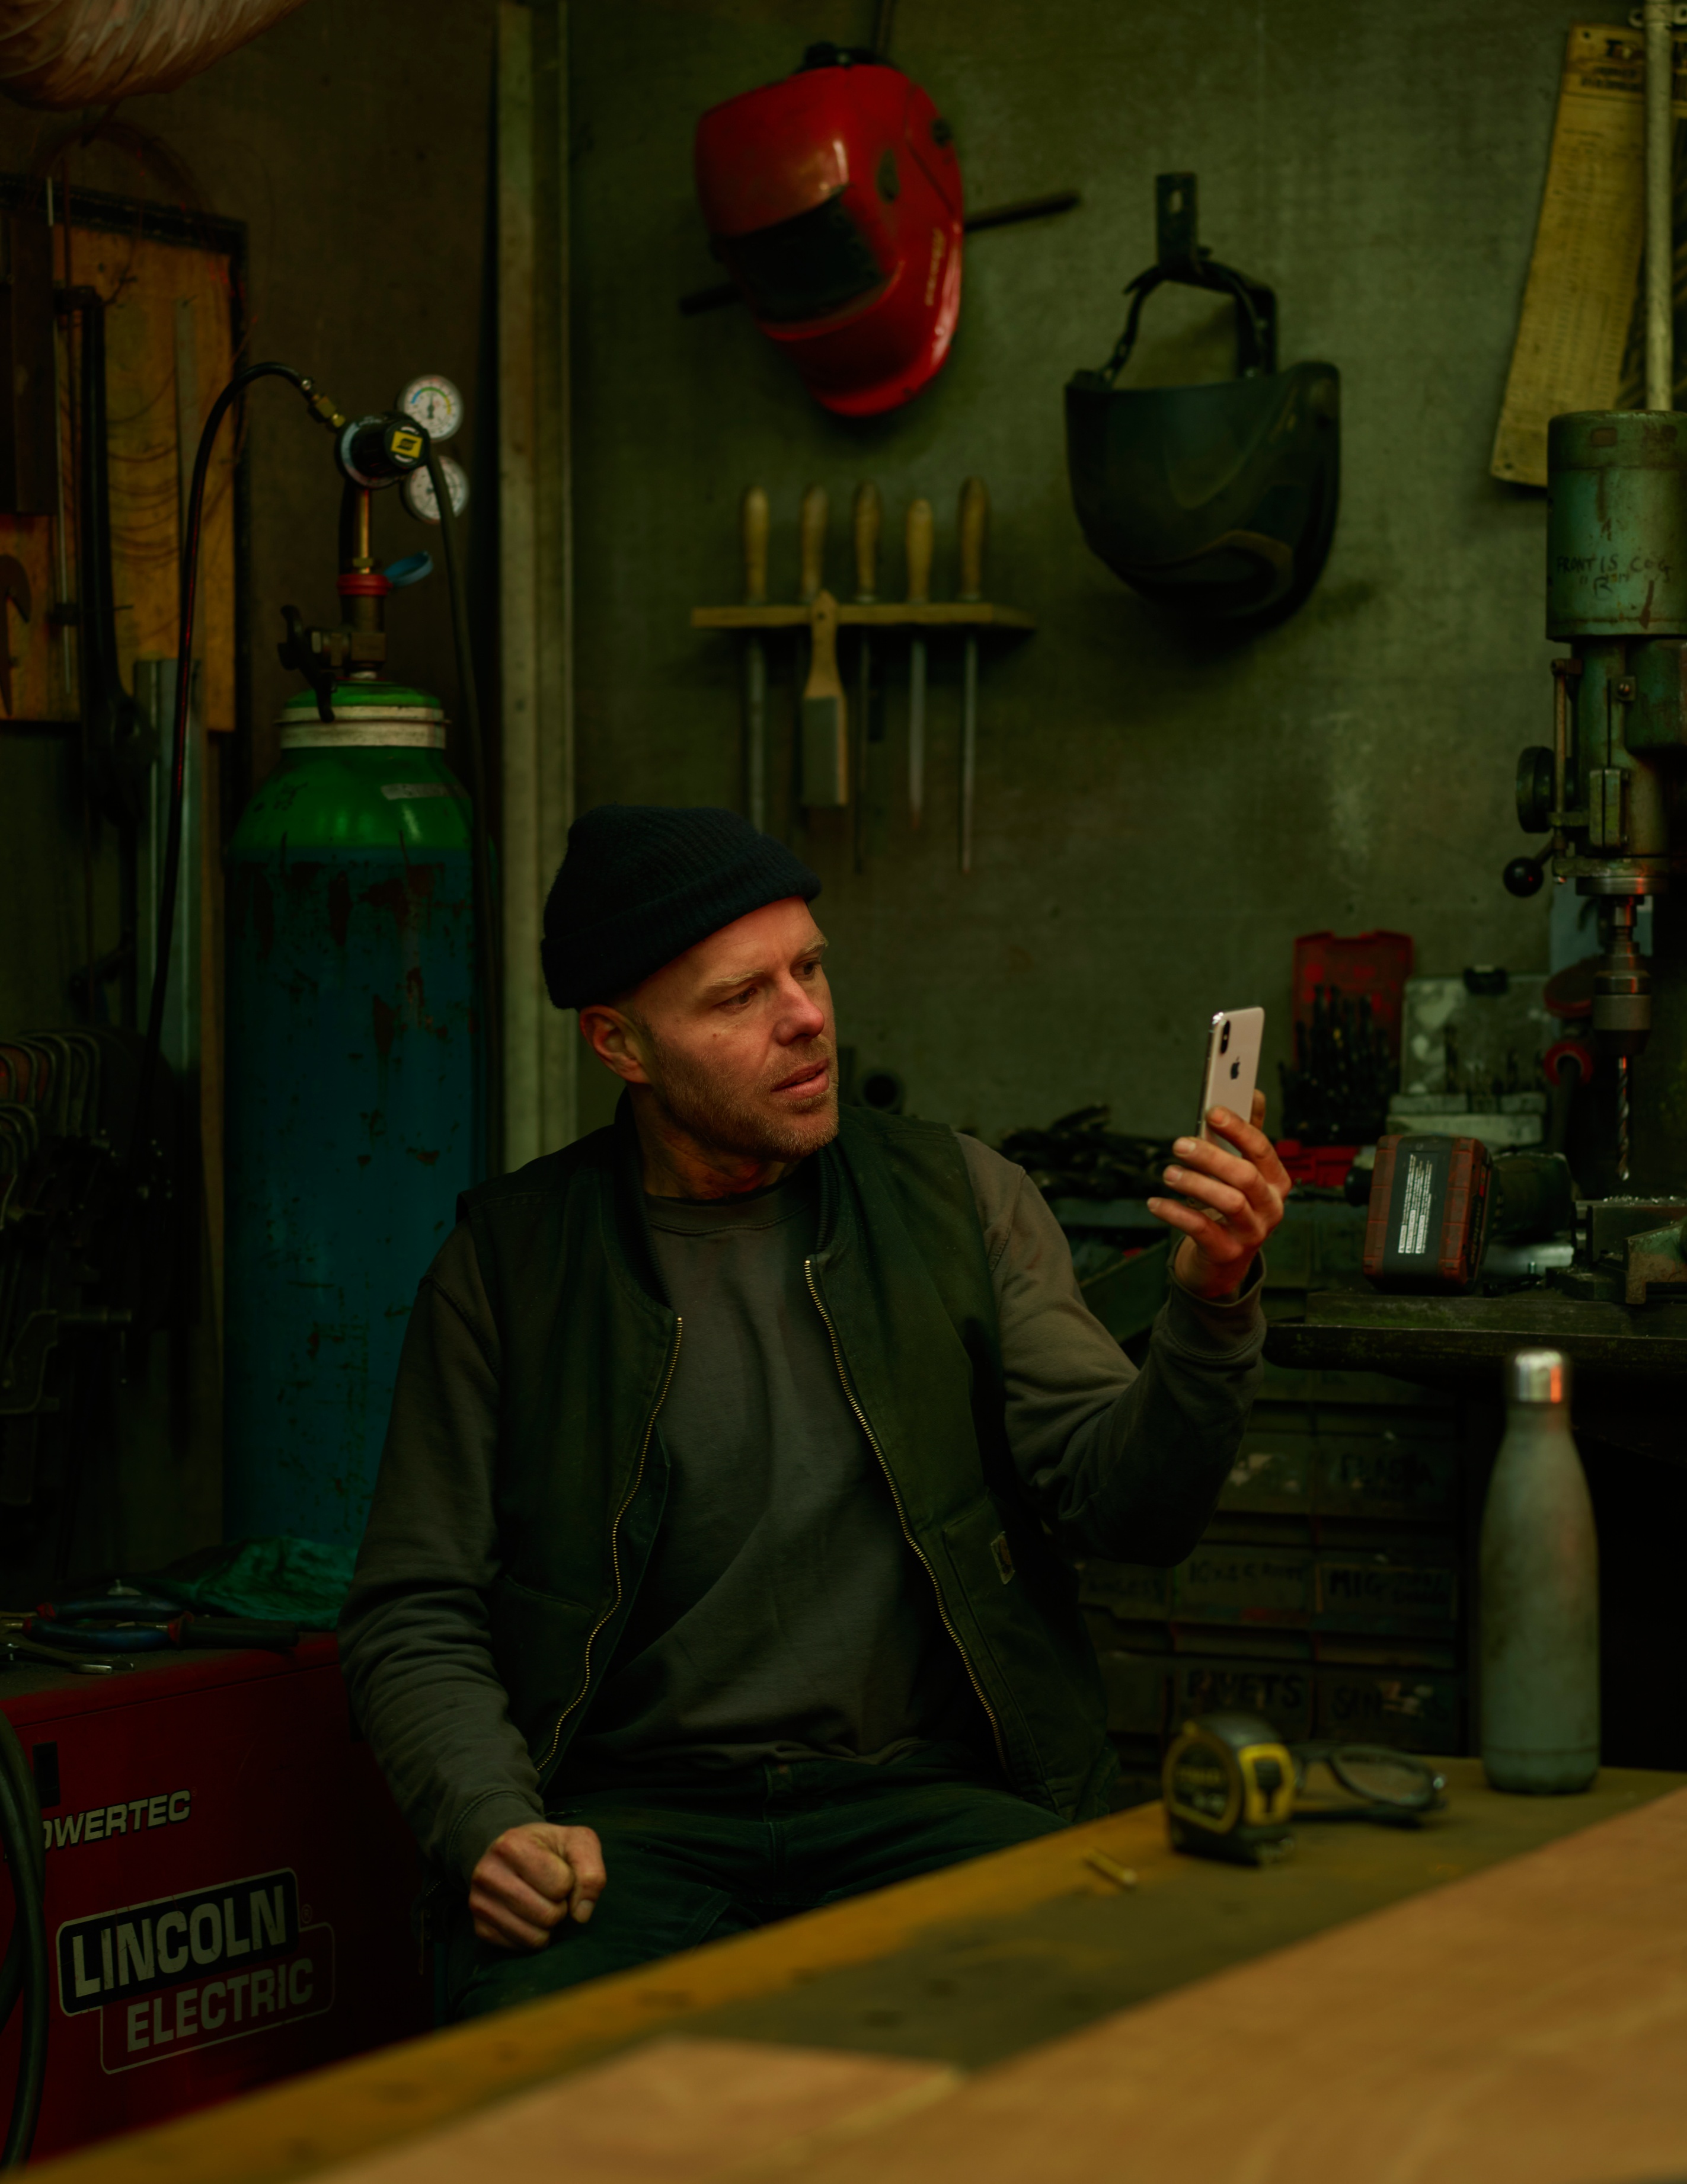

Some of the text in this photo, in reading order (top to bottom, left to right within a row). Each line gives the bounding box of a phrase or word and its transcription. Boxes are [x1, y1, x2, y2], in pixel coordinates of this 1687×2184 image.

[1557, 555, 1596, 574] FRONT
[1599, 554, 1619, 573] IS
[1329, 1570, 1385, 1598] MIG
[72, 1885, 287, 1998] LINCOLN
[126, 1957, 314, 2053] ELECTRIC
